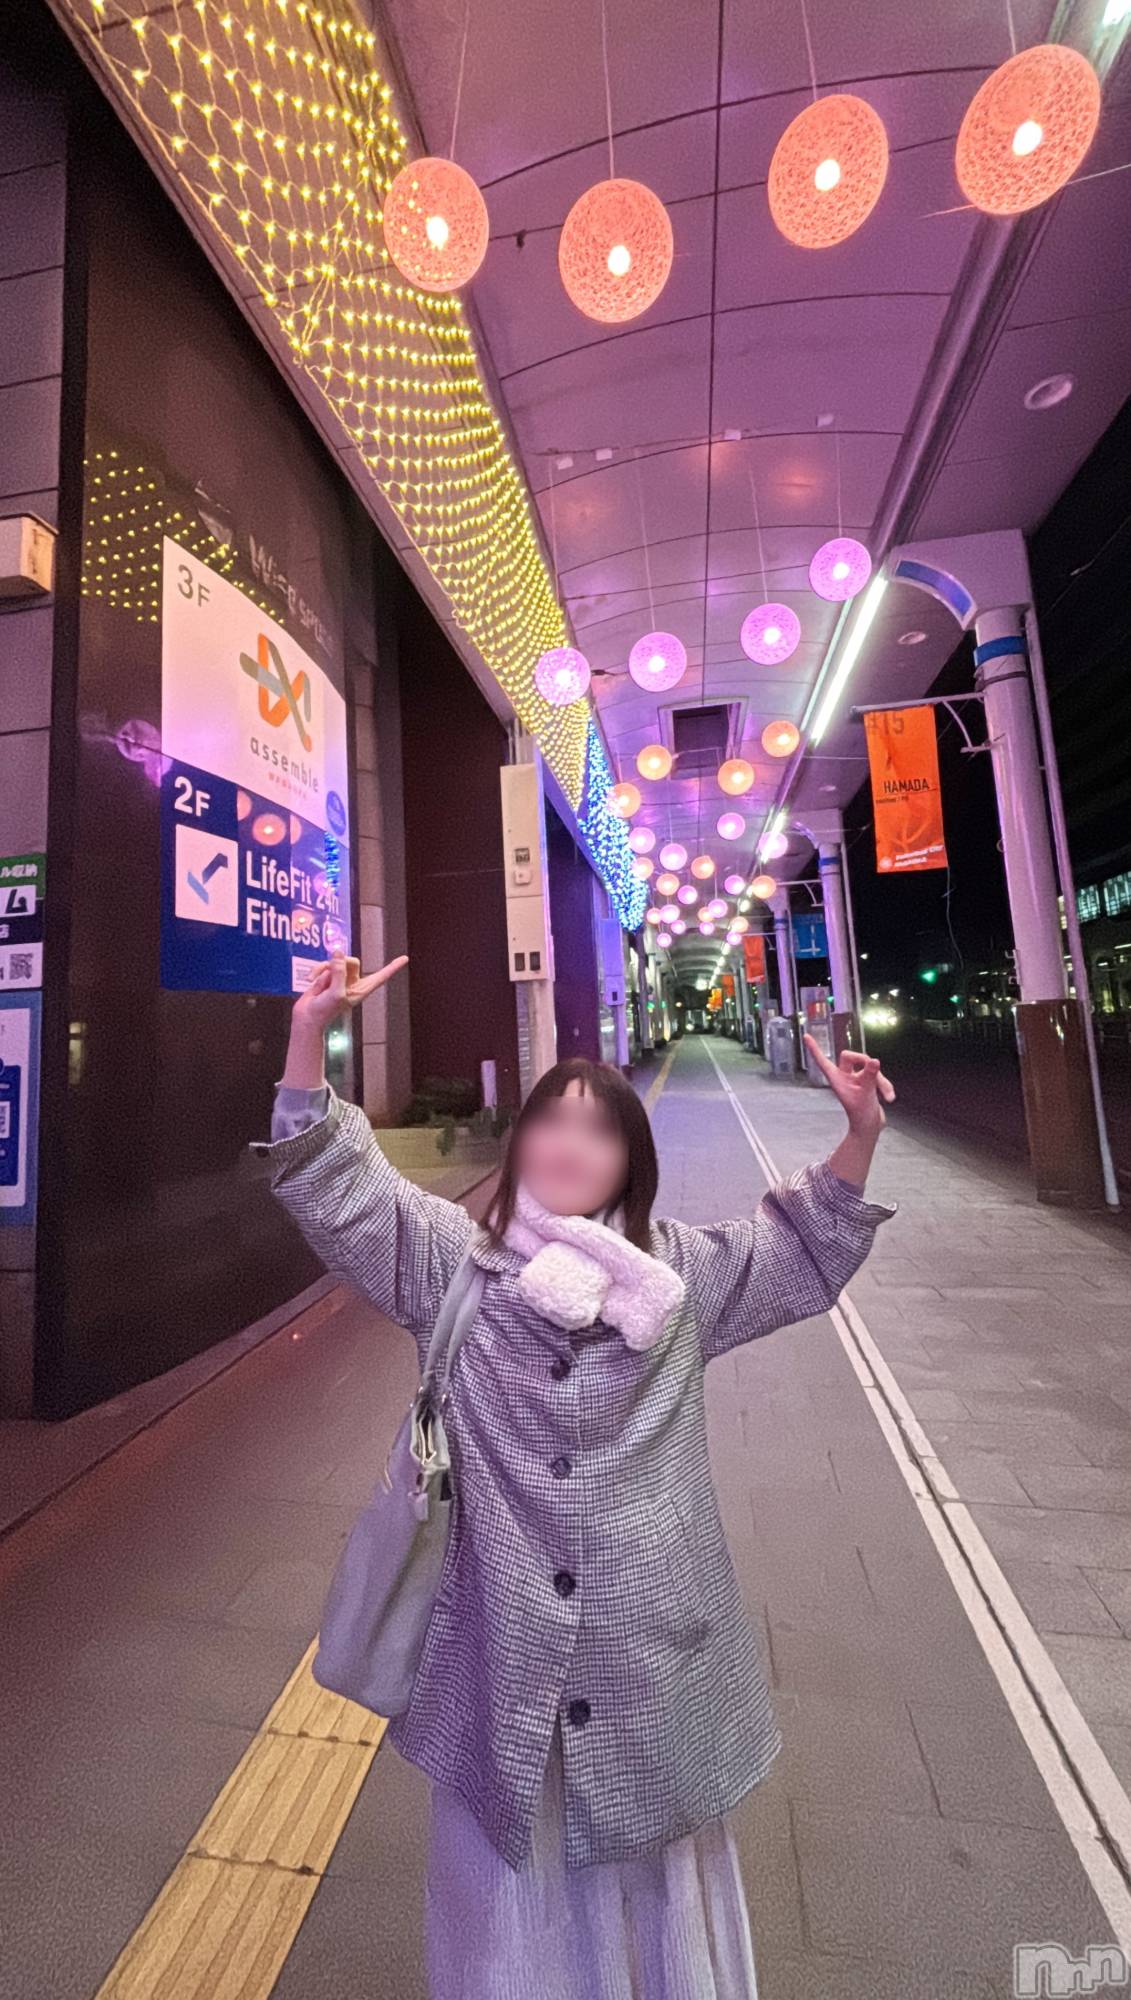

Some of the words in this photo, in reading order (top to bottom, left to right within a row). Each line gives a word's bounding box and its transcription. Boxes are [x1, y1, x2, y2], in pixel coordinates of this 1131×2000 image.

[178, 564, 210, 607] 3F
[250, 736, 318, 793] assemble
[883, 778, 930, 794] HAMADA
[174, 775, 211, 817] 2F
[246, 850, 312, 905] LifeFit
[246, 897, 320, 948] Fitness
